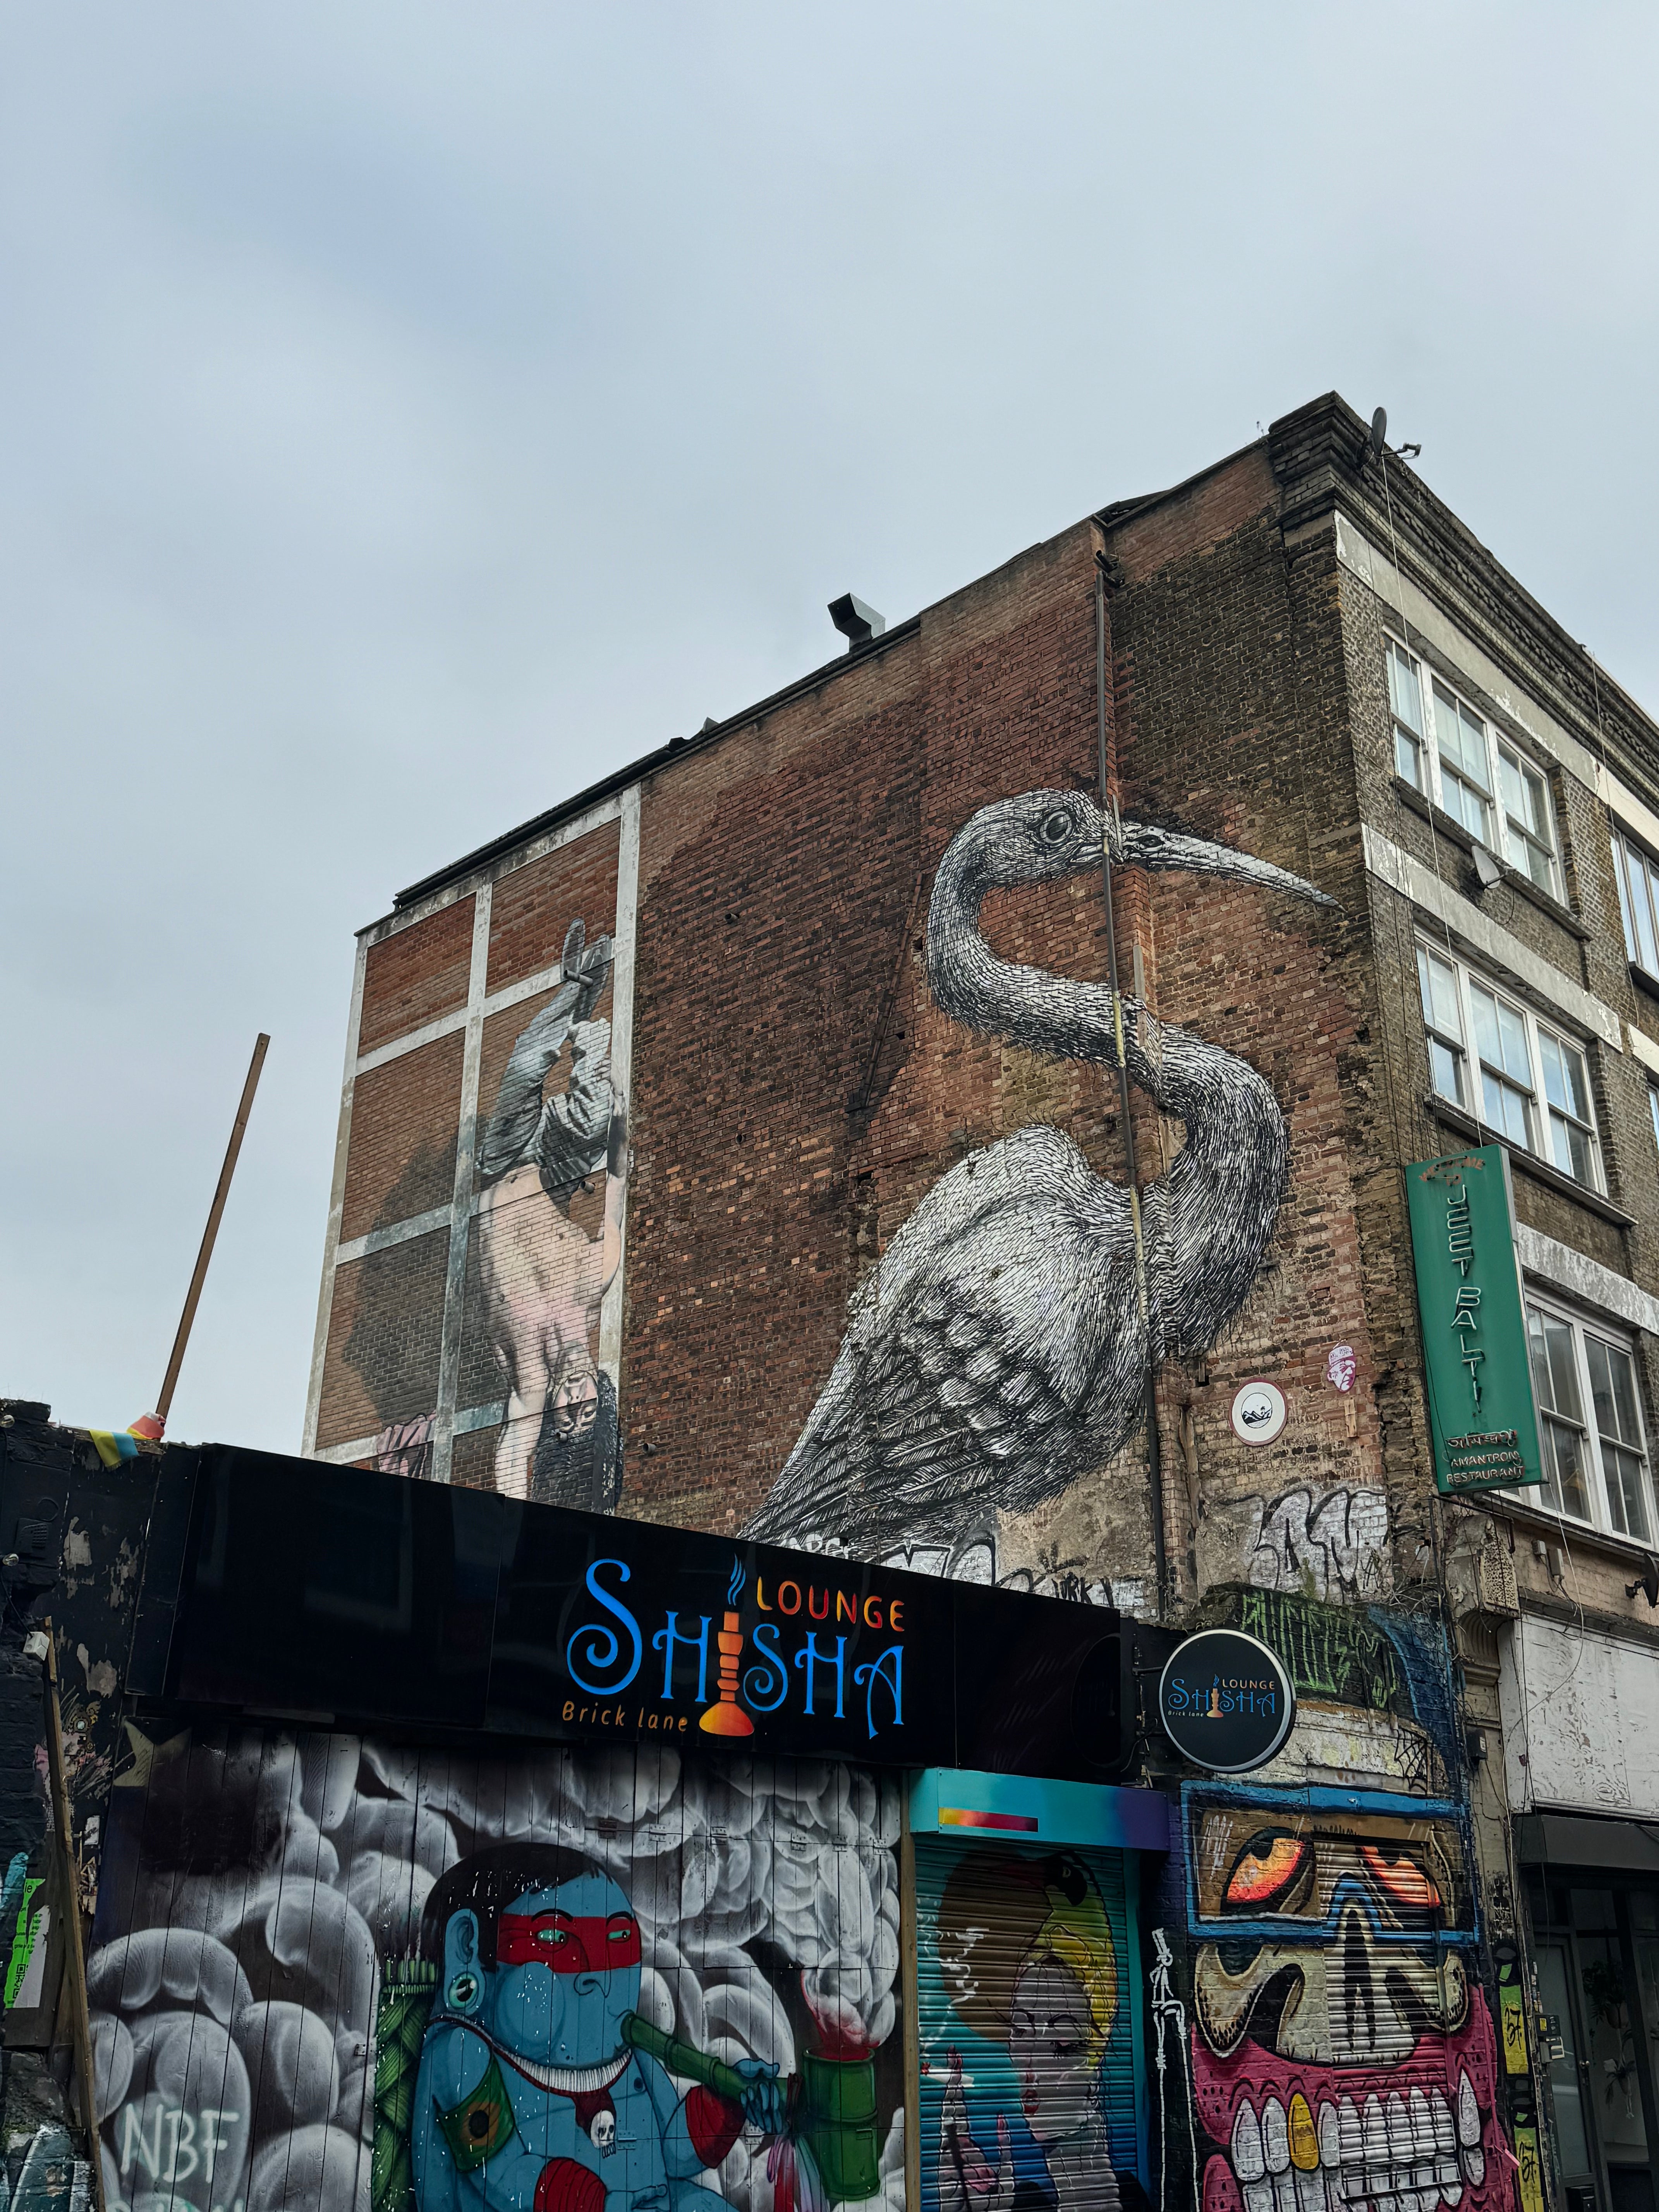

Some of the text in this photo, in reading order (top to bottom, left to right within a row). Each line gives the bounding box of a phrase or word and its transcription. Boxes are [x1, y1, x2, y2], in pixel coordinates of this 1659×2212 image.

[1451, 1286, 1485, 1413] BALTI
[1446, 1466, 1525, 1484] RESTAURANT
[757, 1576, 905, 1632] LOUNGE
[1222, 1679, 1275, 1690] LOUNGE
[562, 1700, 688, 1732] Brick lane
[120, 2103, 240, 2184] NBF
